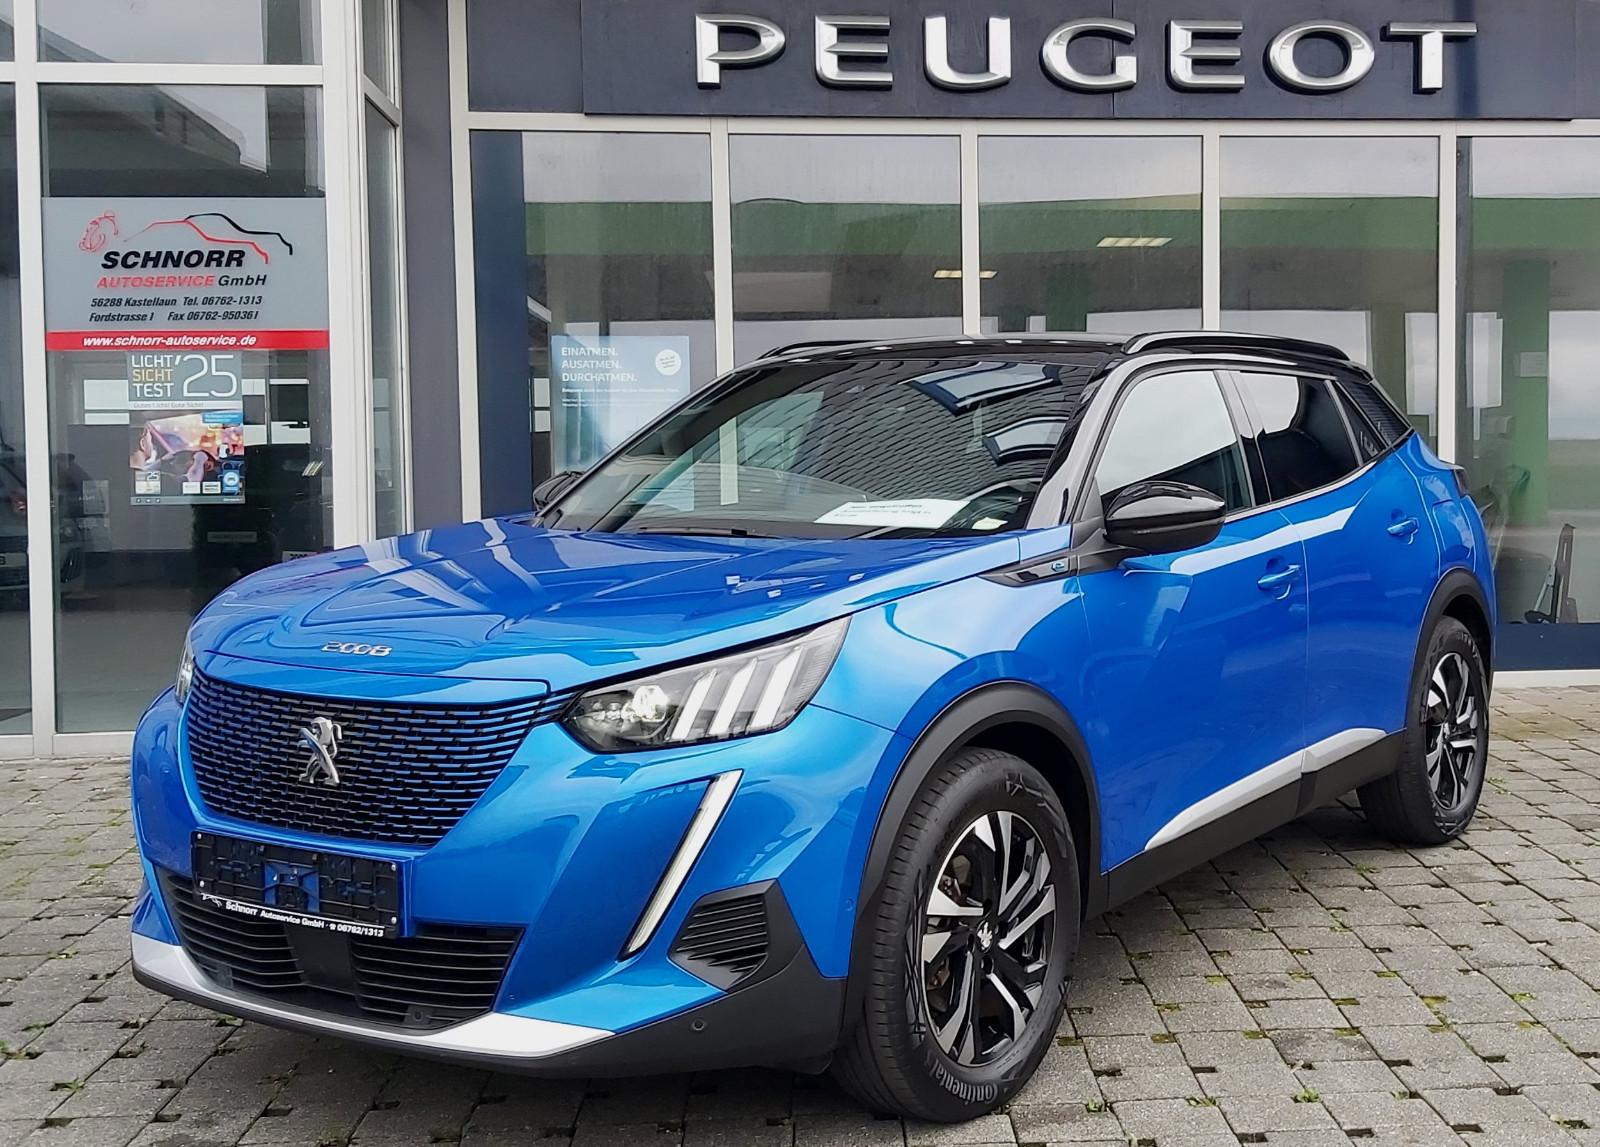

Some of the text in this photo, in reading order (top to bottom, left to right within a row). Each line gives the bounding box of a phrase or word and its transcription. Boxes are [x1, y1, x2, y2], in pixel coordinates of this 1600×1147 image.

[695, 14, 1479, 93] PEUGEOT
[101, 249, 245, 269] SCHNORR
[97, 274, 267, 289] AUTOSERVICE GmbH
[91, 295, 262, 308] 56288 Kastellaun Tel. 06762-1313
[89, 312, 148, 323] Fordstrasse
[167, 311, 185, 321] Fax
[186, 310, 259, 321] 06762-950361
[83, 333, 257, 346] www.schnorr-autoservice.de
[561, 347, 618, 356] EINATMEN.
[131, 354, 174, 368] LICHT
[561, 360, 623, 369] AUSATMEN.
[132, 368, 174, 382] SICHT
[562, 373, 638, 382] DURCHATMEN.
[132, 382, 175, 398] TEST
[321, 641, 392, 656] 2008
[225, 901, 258, 915] Schnorr
[260, 910, 300, 923] Autoservice
[301, 918, 325, 929] GmbH
[928, 1057, 998, 1105] Continental
